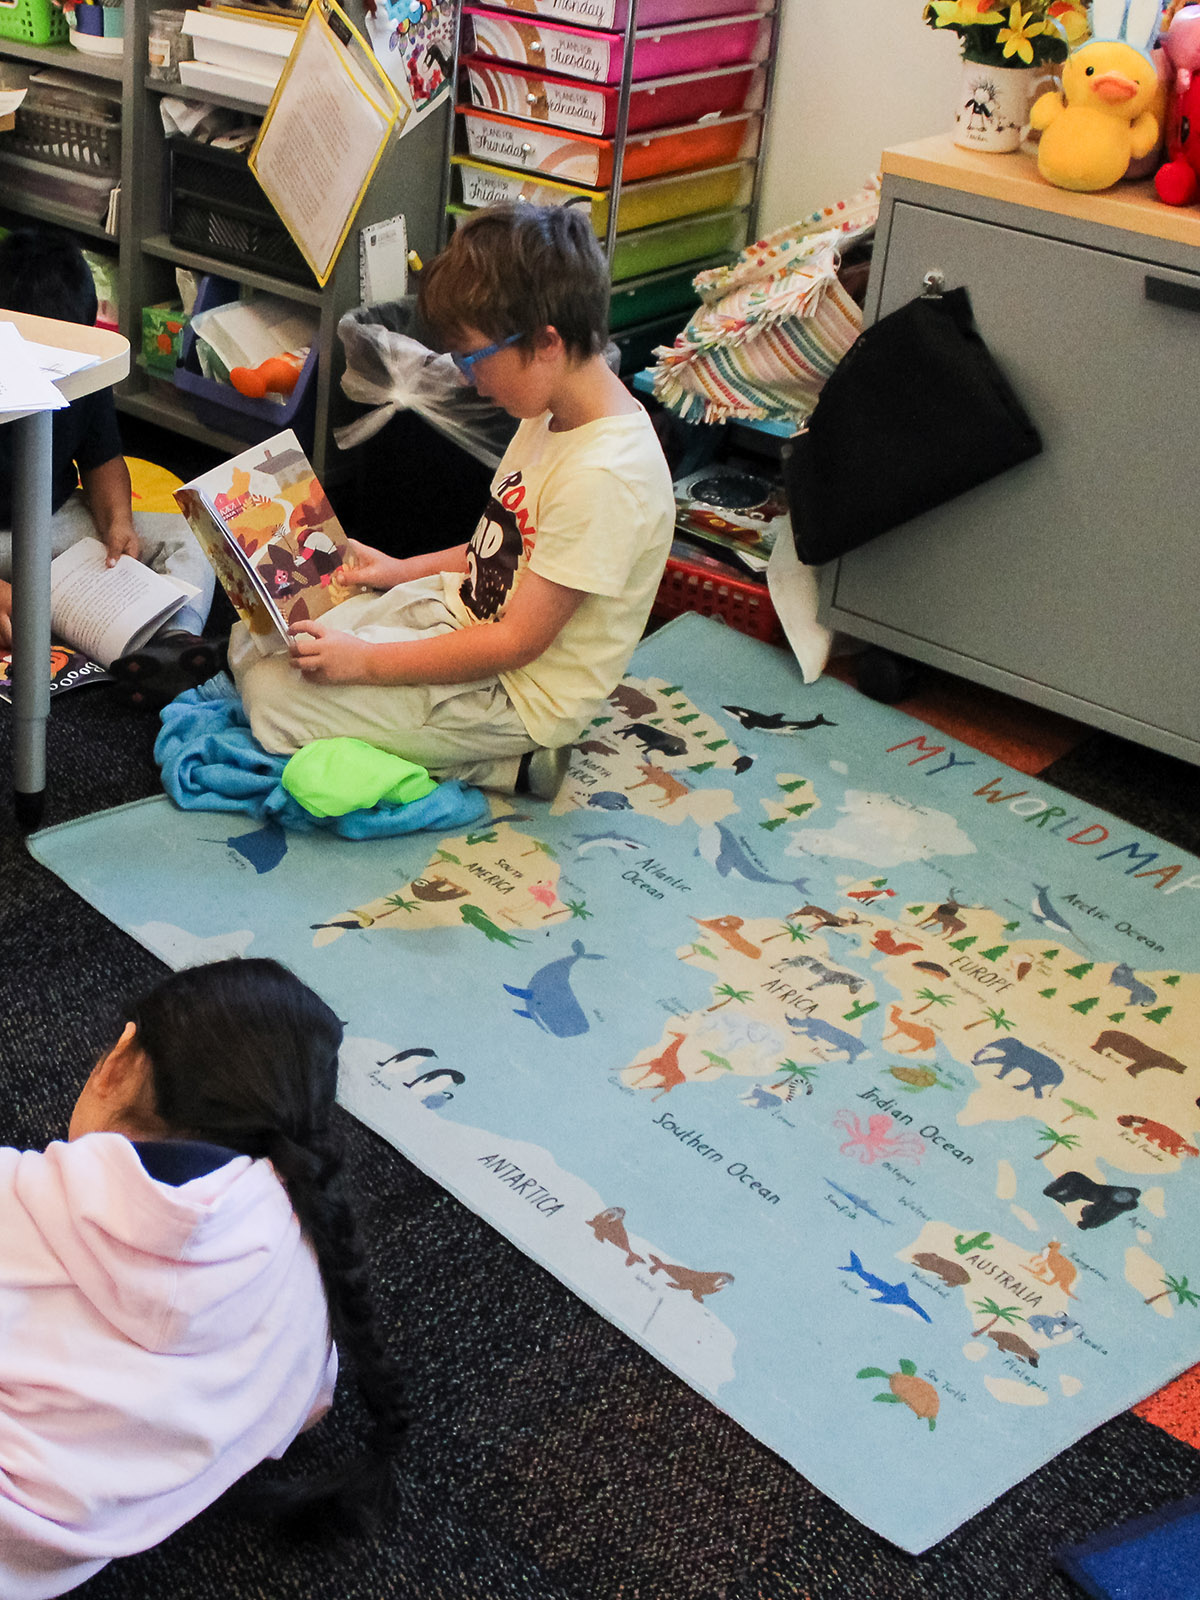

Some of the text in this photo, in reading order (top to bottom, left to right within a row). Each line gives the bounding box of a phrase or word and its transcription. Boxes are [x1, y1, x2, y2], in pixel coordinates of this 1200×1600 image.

[550, 47, 602, 79] Tuesday
[475, 133, 528, 164] Thursday
[578, 758, 613, 779] NORTH
[886, 735, 1200, 895] MY WORLD MAP
[463, 862, 516, 895] AMERICA
[494, 857, 525, 879] SOUTH
[621, 870, 665, 900] Ocean
[635, 858, 692, 893] Atlantic
[1061, 893, 1165, 953] Arctic Ocean
[949, 955, 1016, 993] EUROPE
[760, 978, 819, 1016] AFRICA
[856, 1086, 975, 1166] Indian Ocean
[652, 1112, 781, 1205] Southern Ocean
[477, 1153, 565, 1219] ANTARTICA
[965, 1254, 1043, 1308] AUSTRALIA
[1076, 1331, 1108, 1356] Koala
